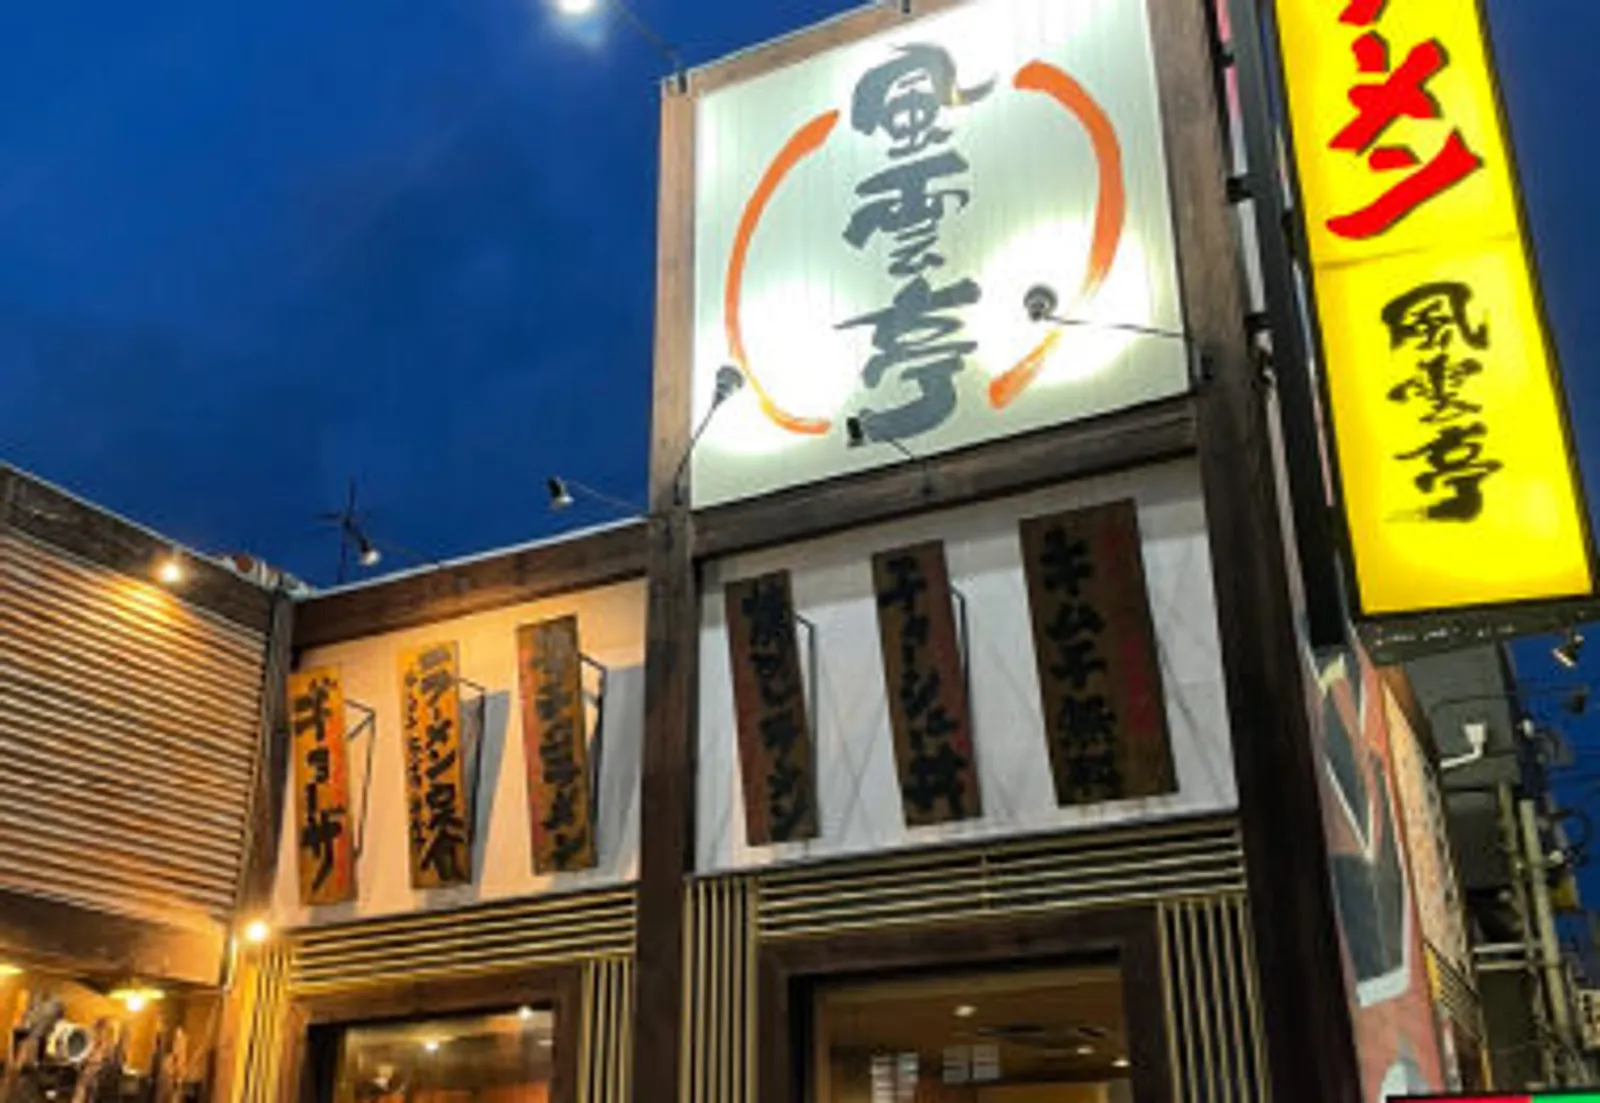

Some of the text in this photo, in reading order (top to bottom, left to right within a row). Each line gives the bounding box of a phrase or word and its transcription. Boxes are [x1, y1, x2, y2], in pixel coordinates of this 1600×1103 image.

[1325, 0, 1485, 240] メン
[834, 41, 997, 443] 風雲亭
[1381, 280, 1504, 523] 風雲亭
[289, 676, 347, 893] ギョーザ
